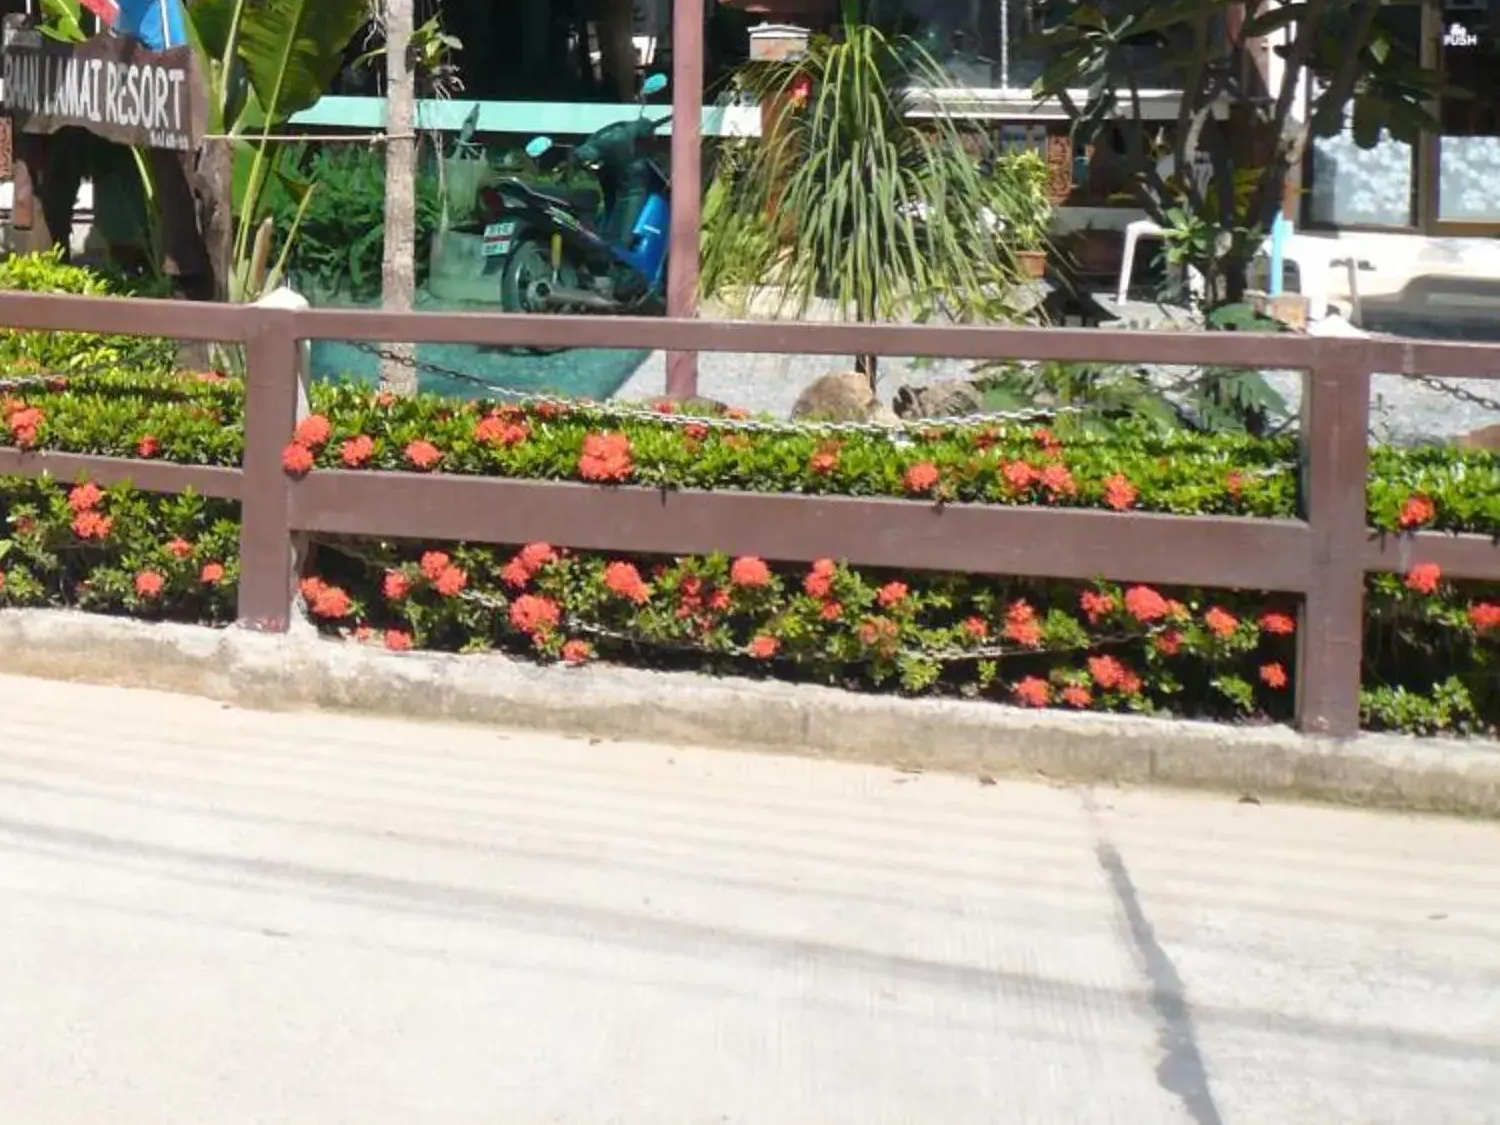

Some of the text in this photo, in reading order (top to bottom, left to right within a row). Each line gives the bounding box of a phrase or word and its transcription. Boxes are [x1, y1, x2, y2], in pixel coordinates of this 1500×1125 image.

[1443, 35, 1478, 46] PUSH
[3, 54, 185, 129] BAAN LAMAI RESORT
